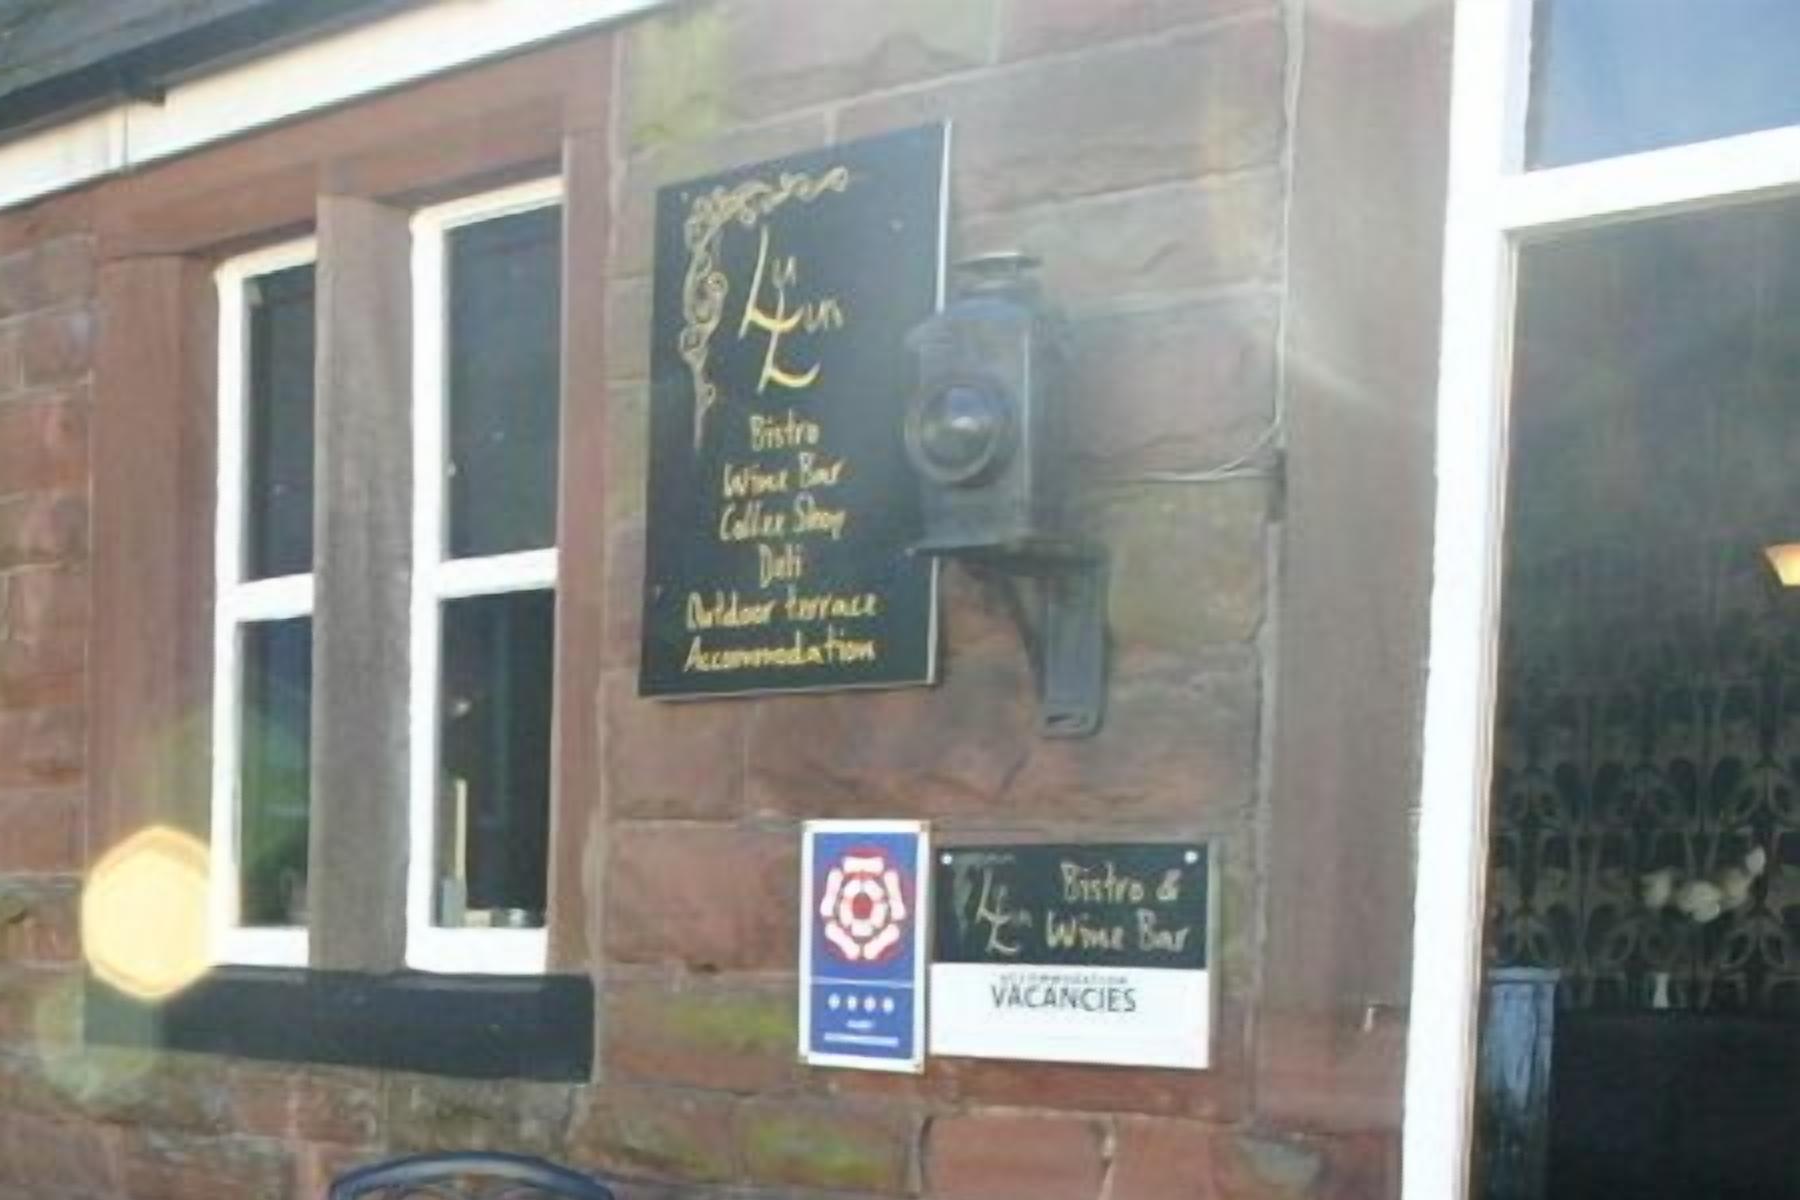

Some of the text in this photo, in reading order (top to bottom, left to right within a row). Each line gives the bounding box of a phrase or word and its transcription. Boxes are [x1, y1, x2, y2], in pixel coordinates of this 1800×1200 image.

[751, 409, 819, 451] Bistro
[724, 452, 846, 497] Wine Bar
[758, 543, 802, 588] Deli
[1060, 861, 1144, 903] Bistro
[1046, 908, 1124, 949] Wine
[1136, 907, 1191, 952] Bar
[990, 983, 1136, 1012] VACANCIES
